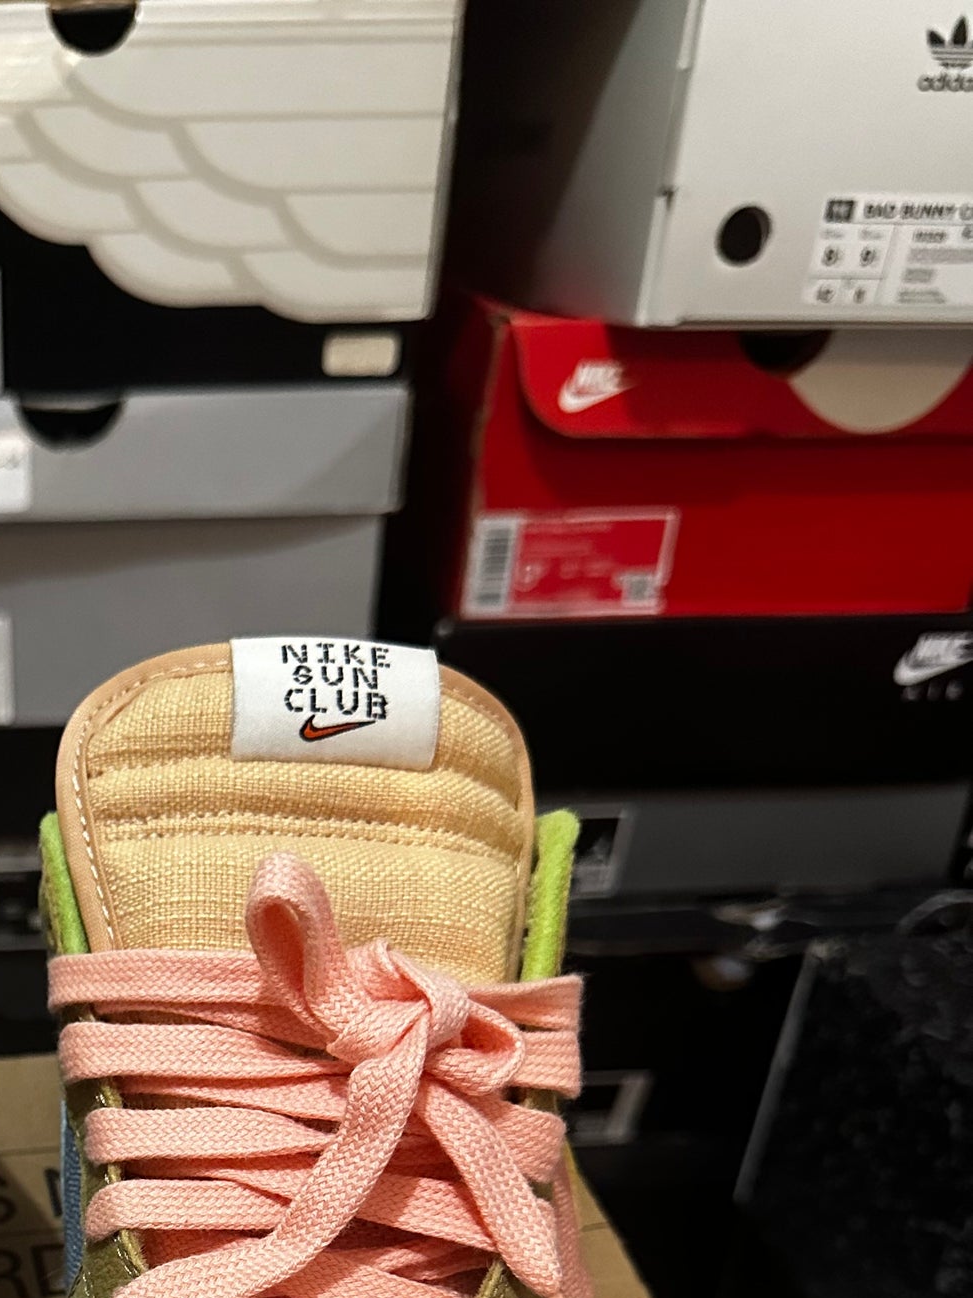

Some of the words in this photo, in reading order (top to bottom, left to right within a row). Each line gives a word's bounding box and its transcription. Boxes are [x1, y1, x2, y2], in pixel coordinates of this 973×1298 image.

[900, 202, 956, 220] BUNNY
[281, 643, 390, 668] NIKE
[292, 665, 378, 689] SUN
[284, 688, 388, 720] CLUB
